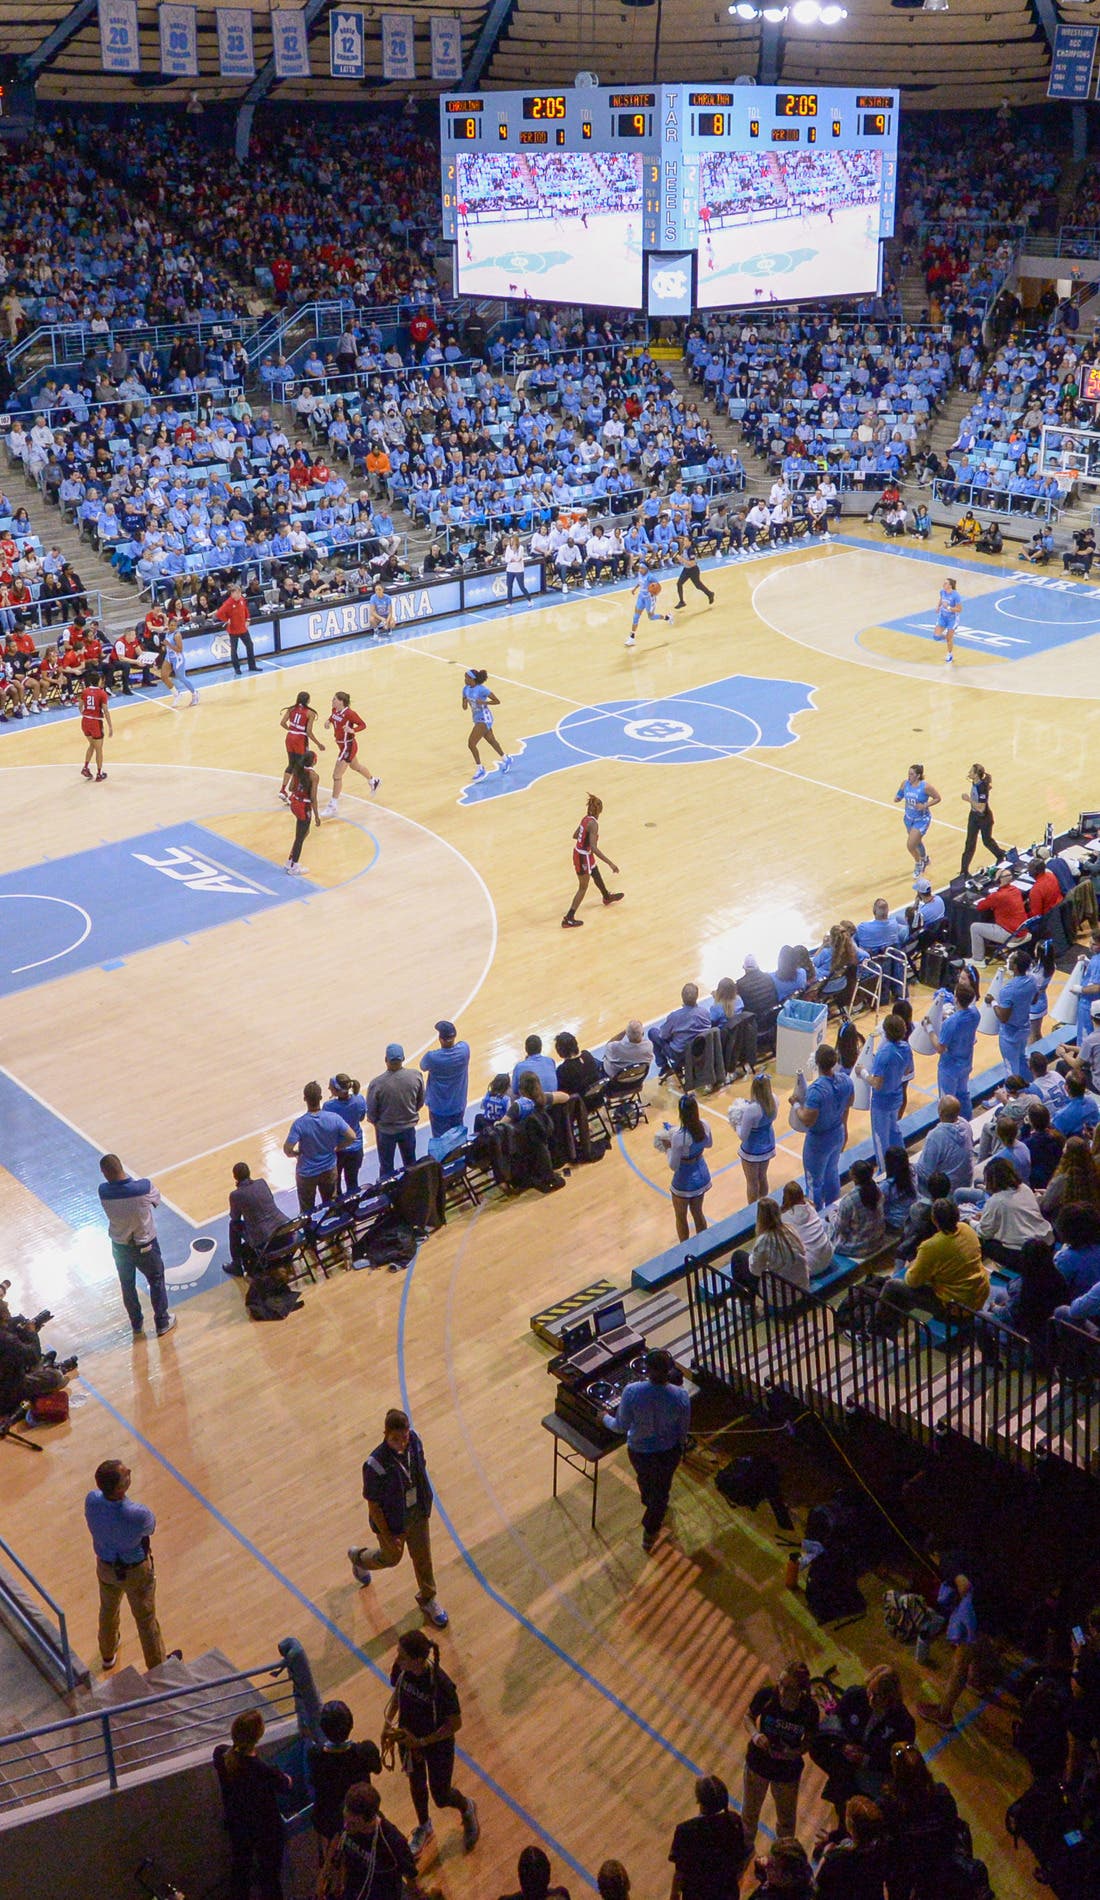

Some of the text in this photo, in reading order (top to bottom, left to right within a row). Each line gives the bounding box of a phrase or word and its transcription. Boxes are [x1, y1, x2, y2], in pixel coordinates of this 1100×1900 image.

[110, 27, 128, 45] 20
[341, 37, 354, 53] 12
[443, 41, 450, 57] 2
[1057, 49, 1090, 58] CHAMPIONS
[533, 97, 565, 118] 2:05
[693, 94, 730, 105] CAROLINA
[785, 95, 817, 115] 2:05
[466, 118, 475, 139] 8
[500, 126, 507, 138] 4
[583, 124, 591, 137] 4
[633, 115, 643, 135] 9
[713, 114, 723, 135] 8
[751, 122, 759, 135] 4
[833, 123, 840, 135] 4
[876, 115, 884, 134] 9
[560, 131, 564, 143] 1
[811, 129, 816, 142] 1
[448, 165, 455, 179] 2
[651, 166, 658, 182] 3
[665, 93, 678, 242] TAR HEELS
[888, 162, 894, 176] 3
[1006, 571, 1077, 591] TAR
[309, 590, 434, 640] CAROINA
[87, 696, 95, 705] 21
[294, 713, 302, 724] 11
